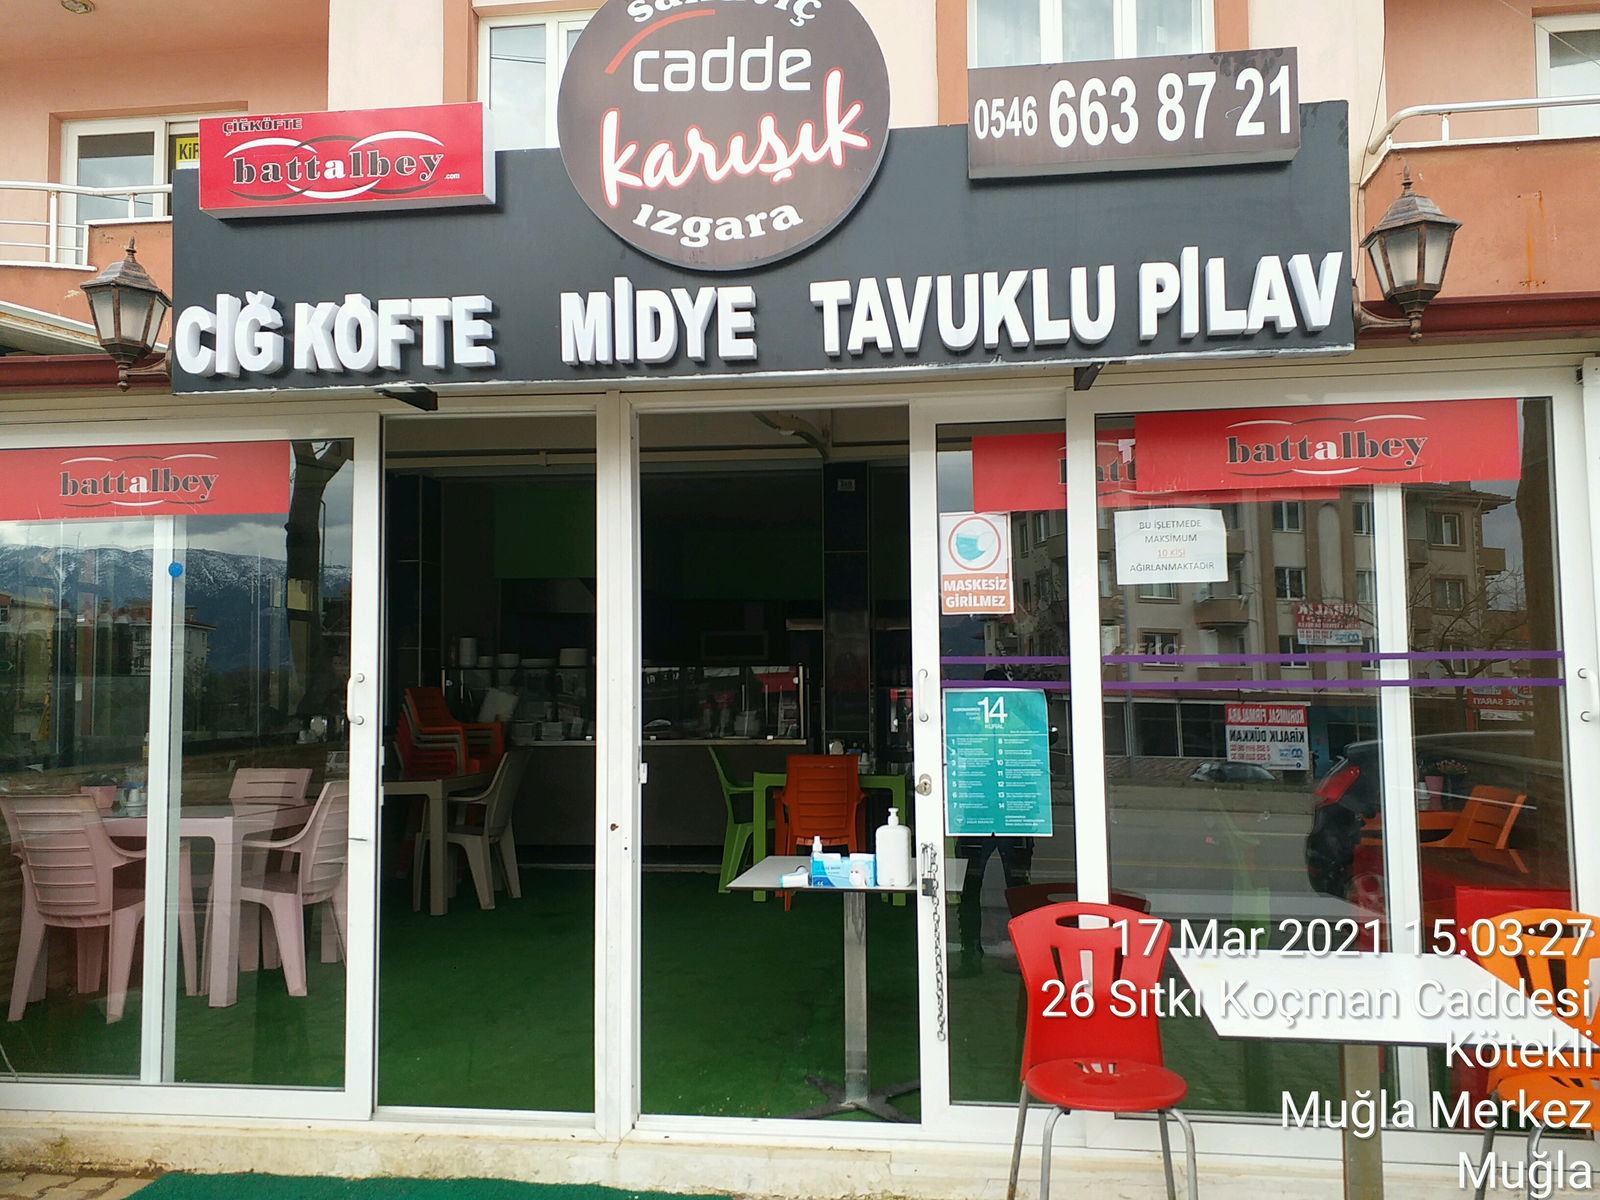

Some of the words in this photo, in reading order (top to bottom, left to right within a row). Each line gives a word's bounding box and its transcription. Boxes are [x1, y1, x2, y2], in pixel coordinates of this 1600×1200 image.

[633, 35, 812, 92] cadde
[974, 96, 1038, 140] 0546
[1049, 76, 1139, 148] 663
[1157, 71, 1217, 142] 87
[1234, 65, 1291, 137] 21
[223, 117, 303, 136] ÇİĞKÖFTE
[600, 67, 871, 208] karışık
[232, 151, 445, 185] battalbey
[809, 264, 1115, 357] TAVUKLU
[1138, 246, 1343, 342] PİLAV
[1226, 431, 1428, 467] battalbey
[60, 468, 219, 501] battalbey
[1139, 521, 1152, 530] BU
[1154, 519, 1202, 530] İŞLETMEDE
[1145, 534, 1198, 543] MAKSİMUM
[1130, 561, 1215, 572] AĞIRLANMAKTADIR
[1157, 549, 1168, 558] 10
[943, 576, 1008, 592] MASKESİZ
[945, 592, 1007, 608] GİRİLMEZ
[977, 696, 1008, 723] 14
